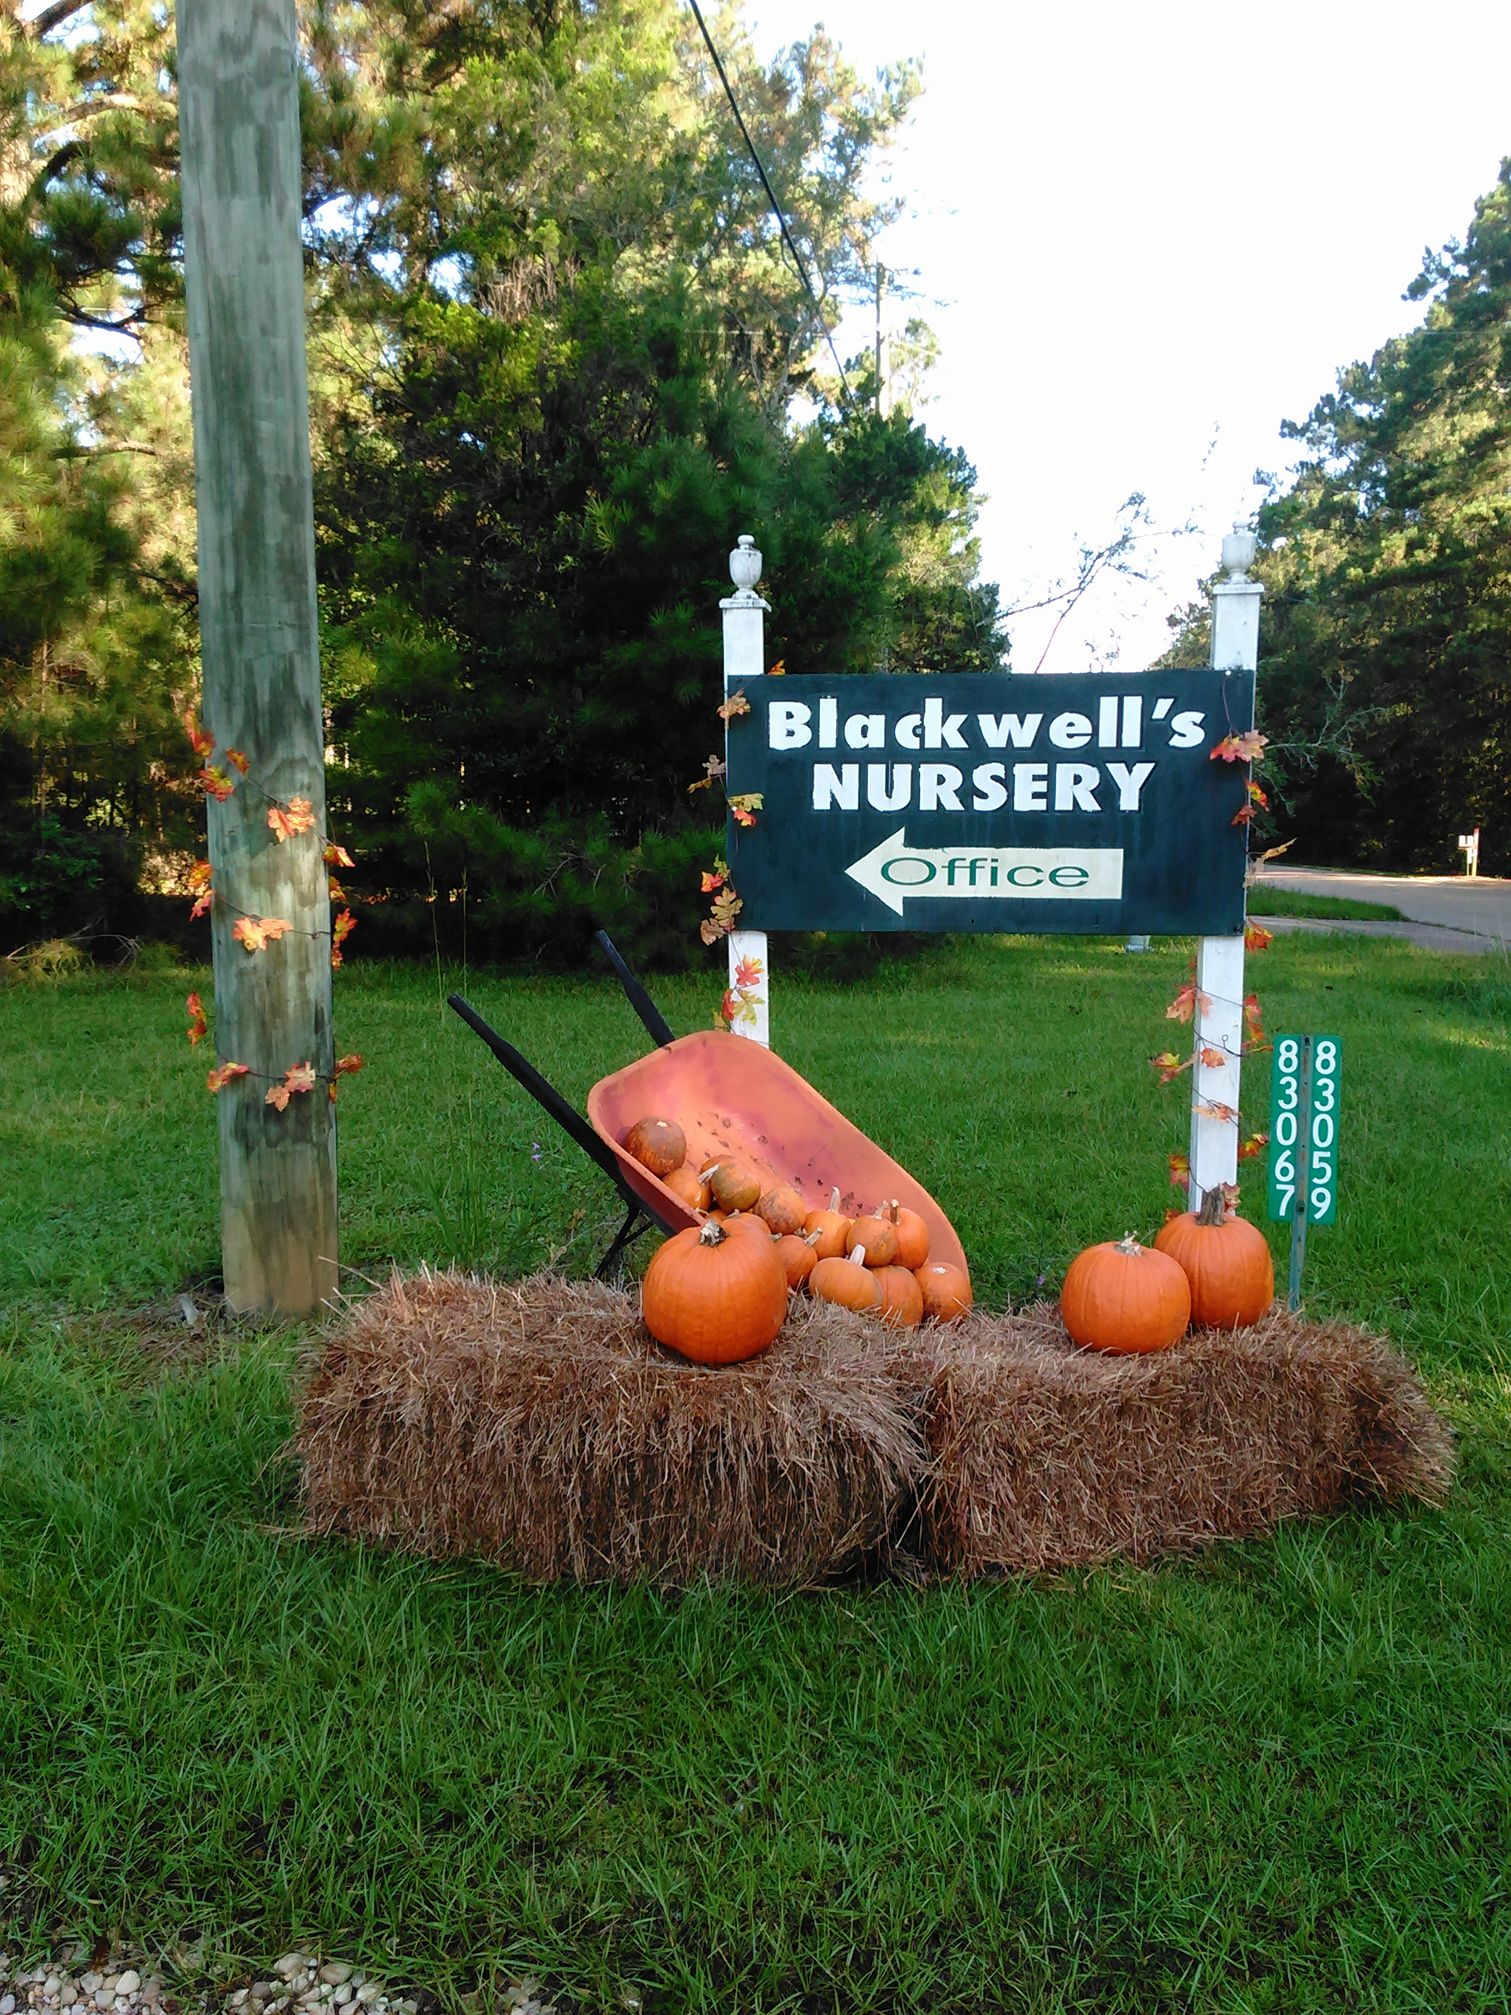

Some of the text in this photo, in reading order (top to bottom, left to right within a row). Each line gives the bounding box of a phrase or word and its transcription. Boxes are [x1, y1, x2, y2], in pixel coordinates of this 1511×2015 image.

[768, 696, 1206, 750] Blackwell's
[812, 761, 1156, 812] NURSERY
[880, 857, 1090, 888] Office
[1274, 1039, 1299, 1217] 83067
[1310, 1040, 1337, 1220] 83059
